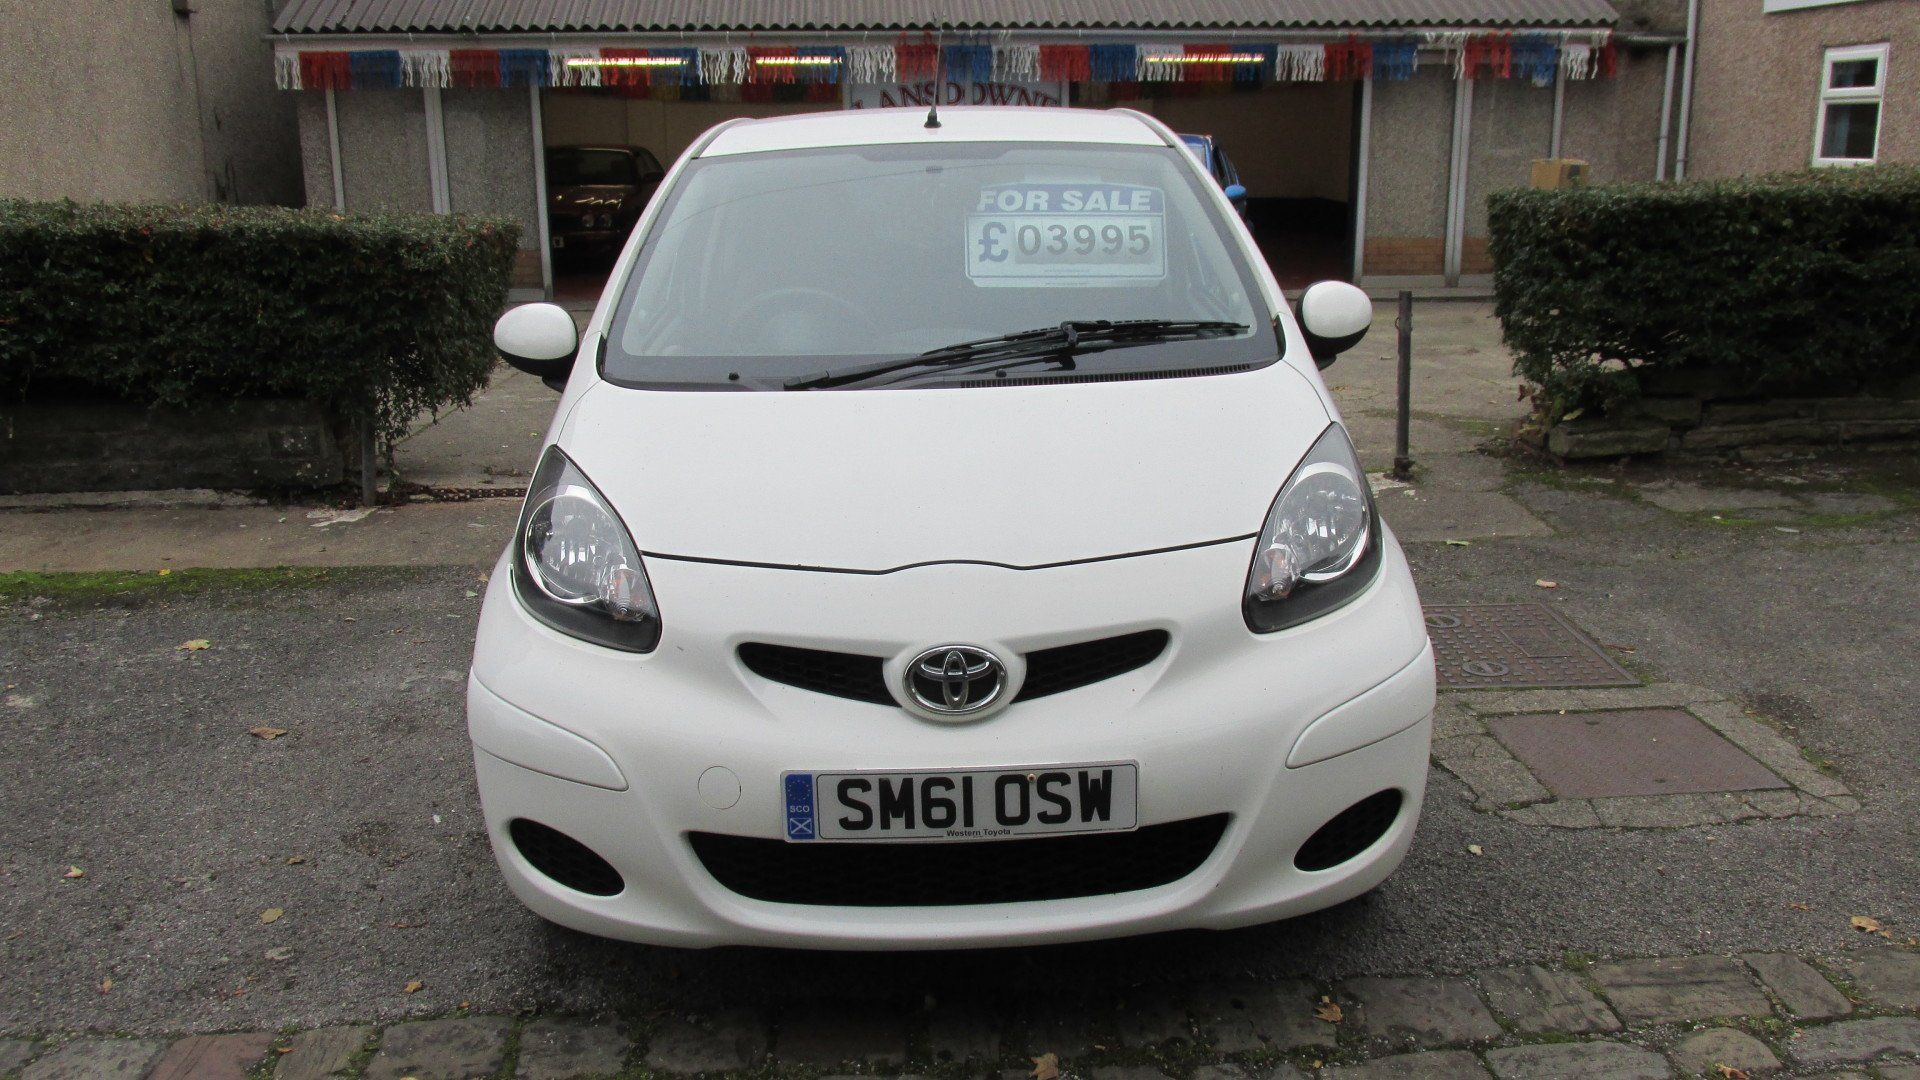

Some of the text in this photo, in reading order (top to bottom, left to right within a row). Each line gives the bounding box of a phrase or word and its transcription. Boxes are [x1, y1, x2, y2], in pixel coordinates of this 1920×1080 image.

[976, 190, 1151, 211] FOR SALE
[837, 770, 1113, 831] SM61 OSW
[789, 805, 810, 813] SCO
[946, 828, 1011, 837] Western Toyota
